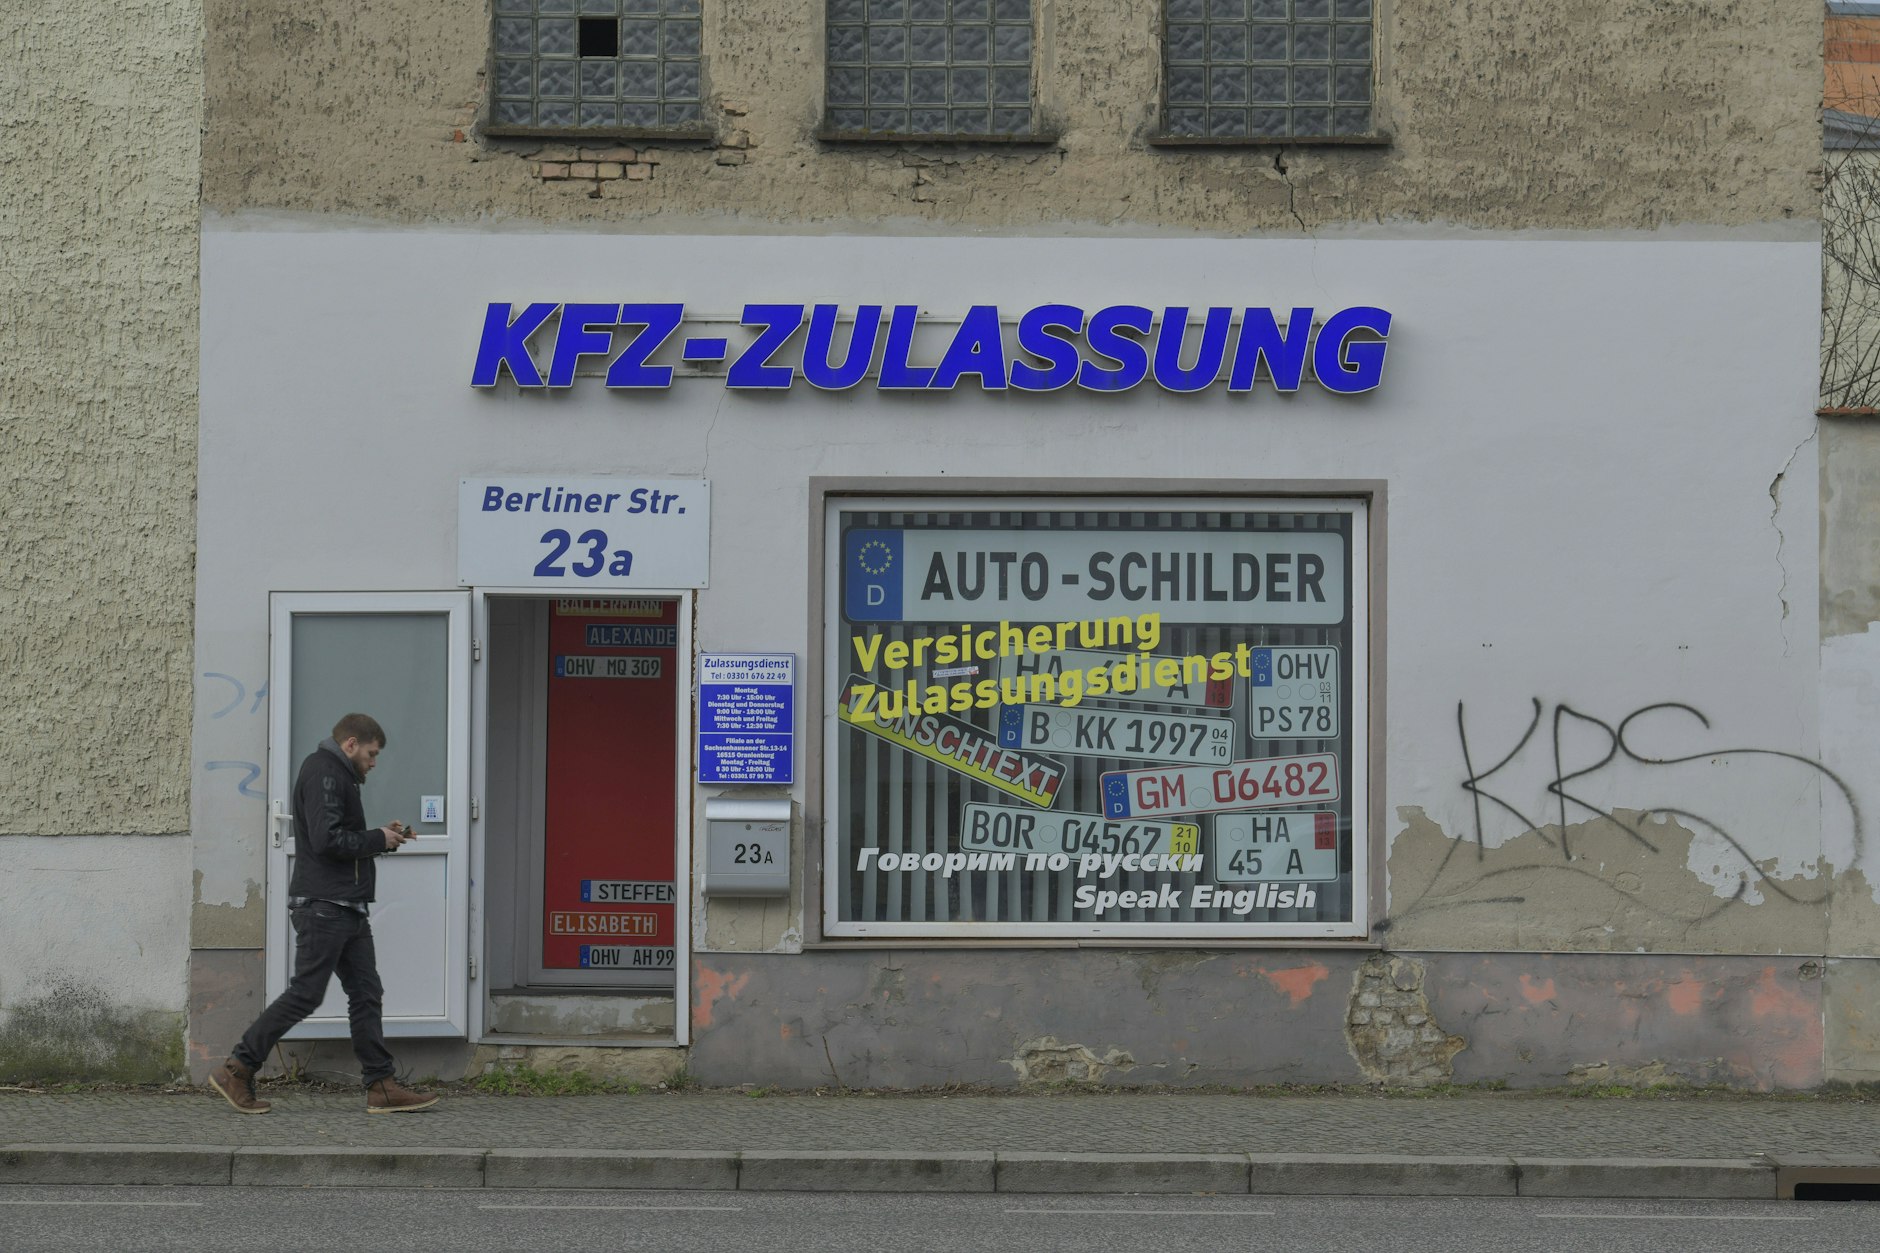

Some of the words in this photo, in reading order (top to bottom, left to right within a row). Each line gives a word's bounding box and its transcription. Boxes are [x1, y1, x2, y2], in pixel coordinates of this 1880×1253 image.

[470, 302, 1392, 393] KFZ-ZULASSUNG
[482, 486, 620, 513] Berliner
[627, 488, 686, 514] Str.
[533, 529, 633, 577] 23a
[867, 584, 885, 606] D
[590, 627, 676, 645] ALEXANDE
[853, 612, 1160, 673] Versicherung
[566, 658, 595, 675] OHV
[631, 659, 660, 676] 309
[704, 658, 789, 670] Zulassungsdienst
[1277, 653, 1330, 680] OHV
[727, 672, 749, 680] 03301
[751, 672, 765, 680] 676
[766, 672, 776, 680] 22
[777, 672, 787, 680] 49
[850, 643, 1250, 722] Zulassungsdienst
[1258, 673, 1266, 682] D
[734, 687, 758, 695] Montag
[1319, 682, 1331, 692] 03
[1320, 694, 1331, 703] 11
[1259, 705, 1292, 732] PS
[1299, 705, 1331, 732] 78
[1007, 730, 1016, 741] D
[1030, 711, 1050, 745] B
[1075, 714, 1117, 750] KK
[1125, 719, 1208, 757] 1997
[1211, 728, 1228, 740] 04
[1210, 746, 1226, 757] 10
[1136, 774, 1187, 810] GM
[1212, 761, 1330, 803] 06482
[1113, 803, 1123, 813] D
[970, 810, 1036, 850] BOR
[1061, 819, 1162, 855] 04567
[1176, 826, 1192, 838] 21
[1252, 816, 1291, 843] HA
[1175, 842, 1190, 852] 10
[857, 848, 1016, 878] Говорим
[1025, 853, 1070, 871] по
[1077, 853, 1204, 879] русски
[1228, 849, 1262, 875] 45
[1286, 848, 1304, 875] A
[1074, 883, 1183, 915] Speak
[1190, 883, 1316, 915] English
[554, 915, 653, 934] ELISABETH
[591, 949, 620, 965] OHV
[633, 949, 652, 966] AH
[656, 950, 675, 966] 99
